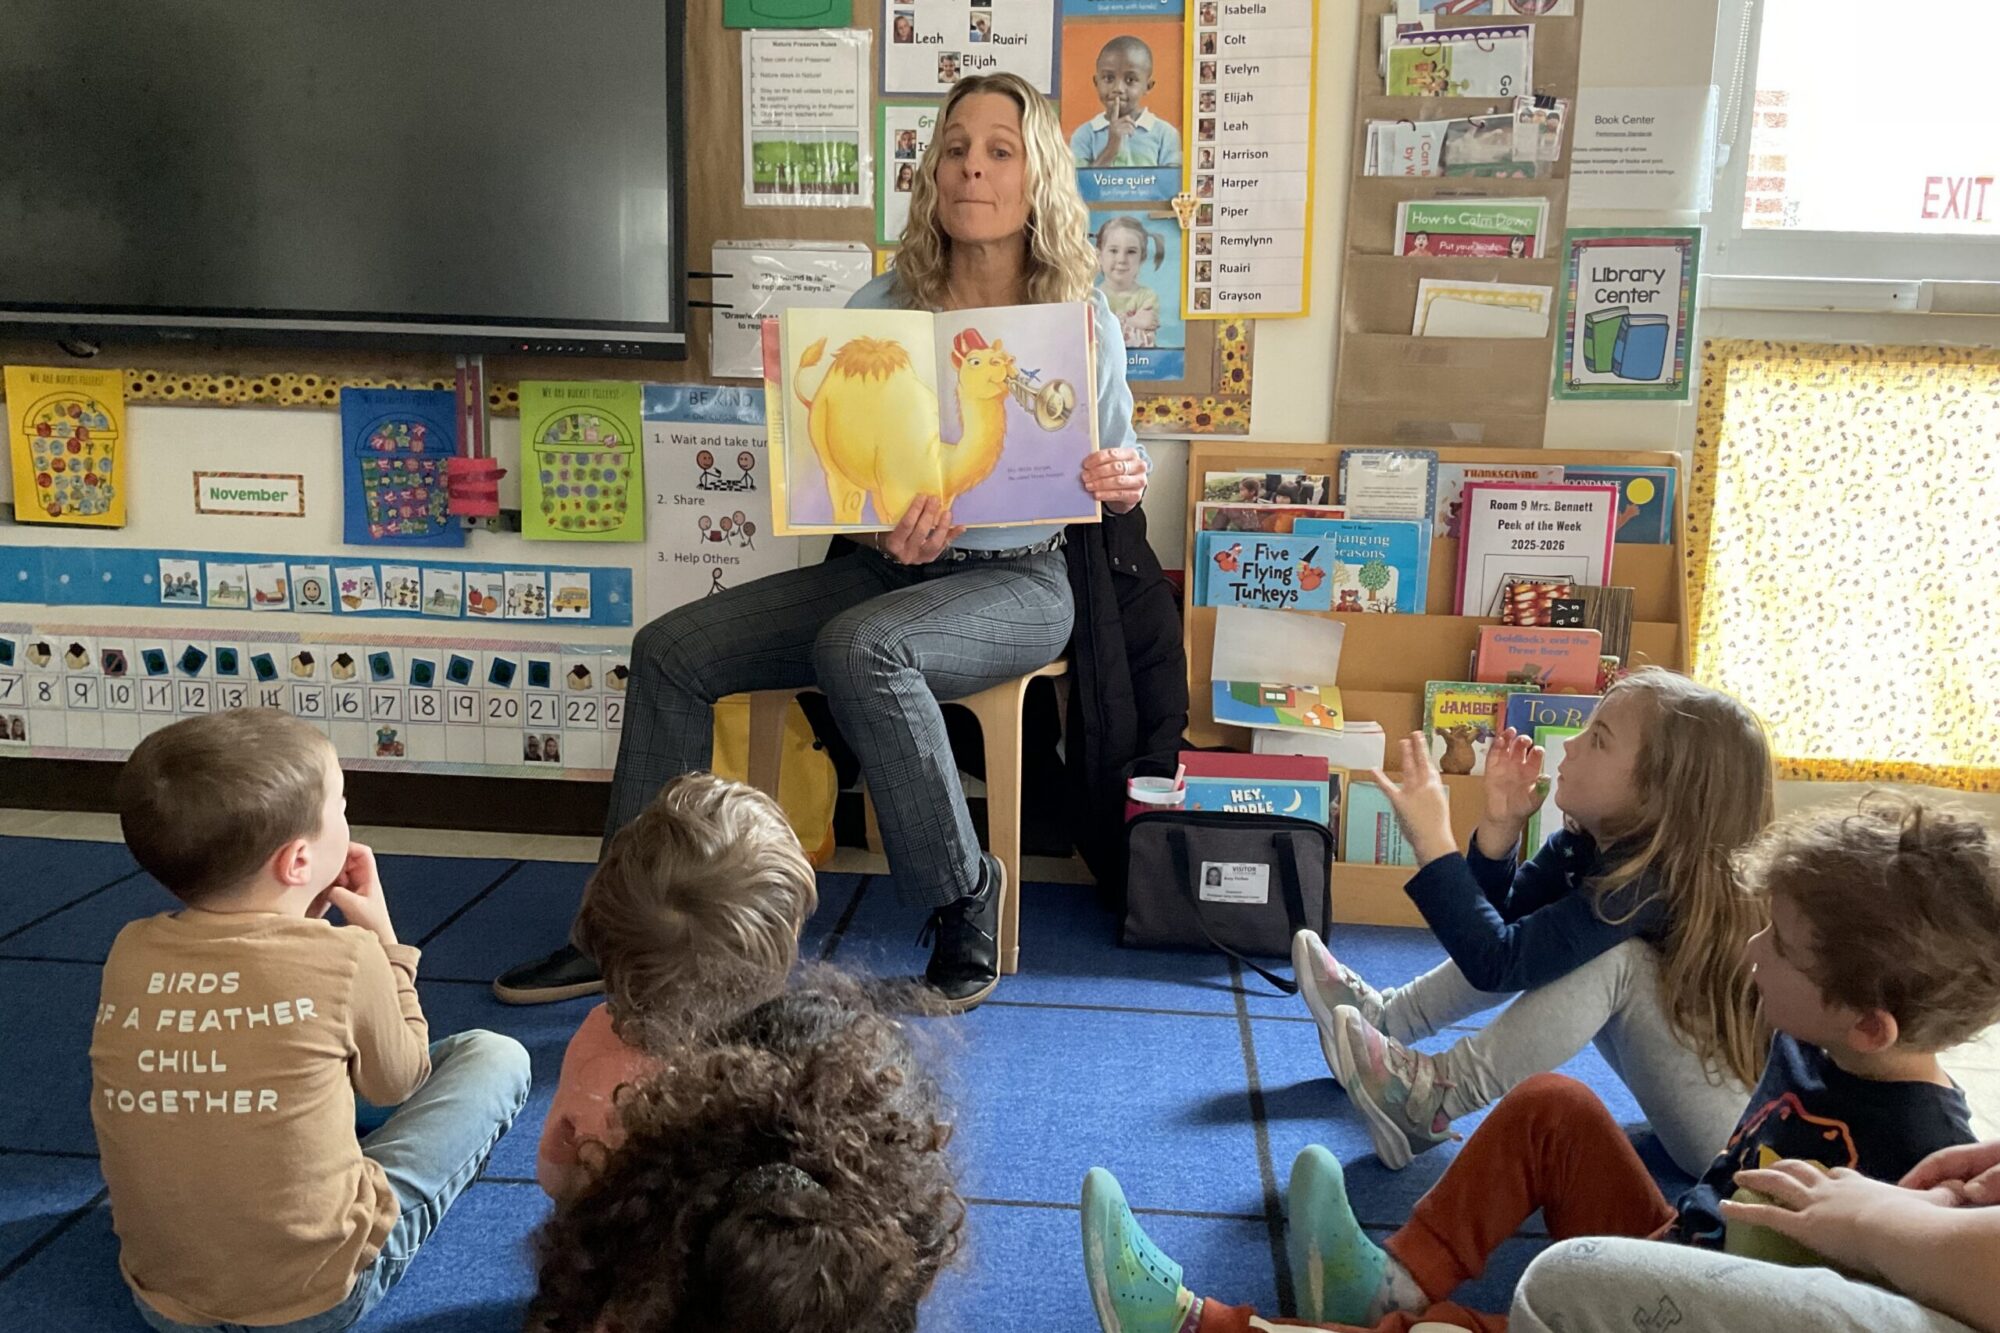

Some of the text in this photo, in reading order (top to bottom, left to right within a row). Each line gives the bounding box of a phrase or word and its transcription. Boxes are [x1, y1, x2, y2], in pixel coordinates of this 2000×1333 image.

[1224, 4, 1267, 14] Isabella
[915, 33, 943, 44] Leah
[993, 33, 1027, 45] Ruairi
[1224, 35, 1246, 45] Colt
[963, 54, 996, 68] Elijah
[1224, 63, 1260, 76] Evelyn
[1224, 92, 1253, 104] Elijah
[1595, 114, 1655, 124] Book Center
[1223, 121, 1249, 131] Leah
[1222, 149, 1269, 159] Harrison
[1094, 174, 1157, 189] Voice quiet
[1221, 178, 1259, 190] Harper
[1921, 176, 1994, 220] EXIT
[1221, 206, 1248, 219] Piper
[1412, 212, 1533, 227] How to Calm Down
[1220, 235, 1273, 248] Remylynn
[1219, 263, 1250, 273] Ruairi
[1592, 267, 1665, 285] Library
[1218, 290, 1262, 302] Grayson
[1595, 287, 1660, 304] Center
[1126, 354, 1150, 365] alm
[689, 391, 753, 408] BE KIND
[654, 433, 664, 444] 1.
[671, 433, 698, 445] Wait
[701, 434, 721, 446] and
[724, 435, 748, 446] take
[210, 487, 288, 502] November
[657, 494, 705, 505] 2. Share
[1490, 499, 1593, 513] Room 9 Mrs. Bennett
[1498, 519, 1582, 532] Peek of the Week
[1511, 539, 1565, 551] 2025-2026
[1255, 543, 1289, 561] Five
[658, 553, 740, 567] 3. Help Others
[1242, 563, 1293, 585] Flying
[1229, 583, 1299, 608] Turkeys
[1, 678, 13, 697] 7
[38, 681, 51, 701] 8
[75, 683, 88, 703] 9
[110, 684, 129, 703] 10
[148, 685, 166, 705] 11
[185, 687, 204, 707] 12
[222, 687, 242, 708] 13
[260, 690, 281, 709] 14
[298, 692, 318, 712] 15
[335, 692, 358, 714] 16
[375, 695, 395, 715] 17
[414, 696, 435, 716] 18
[454, 696, 473, 717] 19
[488, 698, 518, 718] 20
[530, 700, 556, 720] 21
[568, 702, 597, 721] 22
[1231, 788, 1265, 803] HEY,
[147, 972, 240, 994] BIRDS
[122, 1007, 140, 1030] A
[156, 997, 319, 1033] FEATHER
[138, 1049, 227, 1073] CHILL
[104, 1089, 279, 1114] TOGETHER
